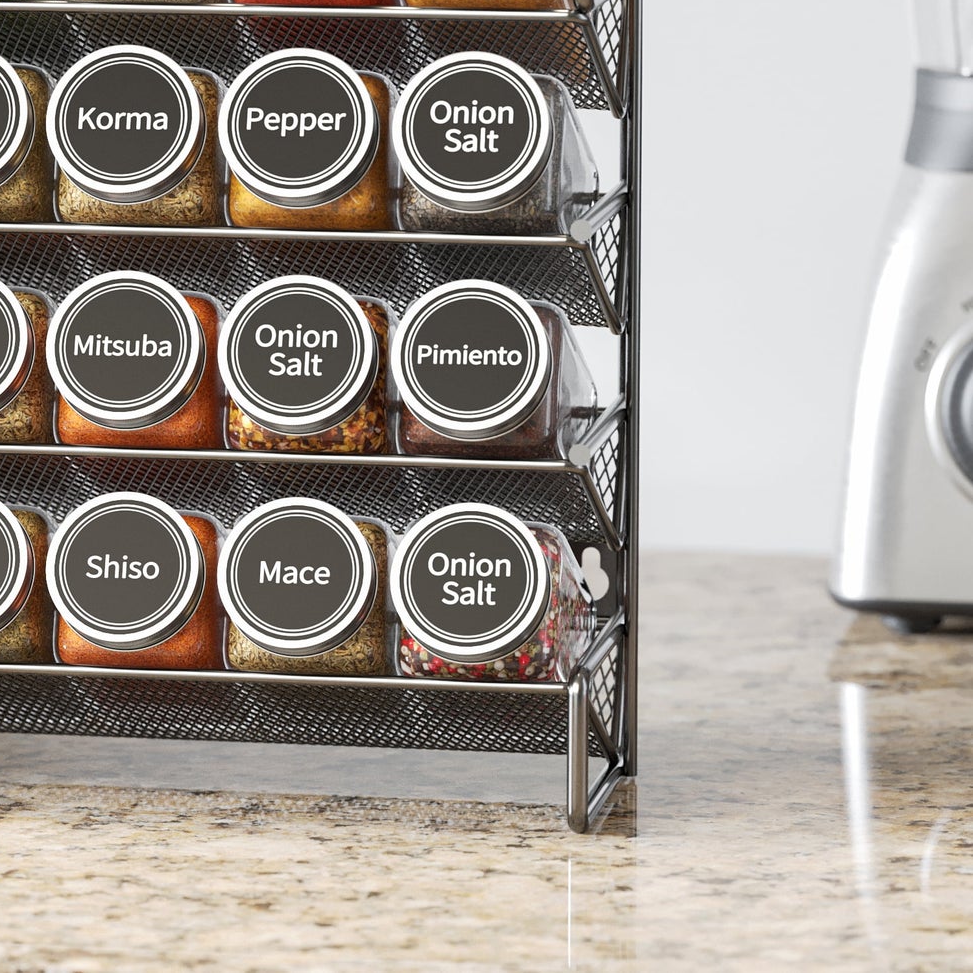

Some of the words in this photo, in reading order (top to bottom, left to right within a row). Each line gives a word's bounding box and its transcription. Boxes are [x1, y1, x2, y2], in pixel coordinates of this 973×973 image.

[77, 106, 169, 131] Korma
[245, 107, 347, 138] Pepper
[429, 99, 515, 125] Onion
[443, 126, 500, 153] Salt
[73, 333, 173, 358] Mitsuba
[254, 323, 338, 349] Onion
[268, 350, 323, 377] Salt
[416, 343, 523, 366] Pimiento
[85, 553, 160, 580] Shiso
[259, 560, 331, 585] Mace
[427, 551, 512, 578] Onion
[441, 579, 497, 606] Salt
